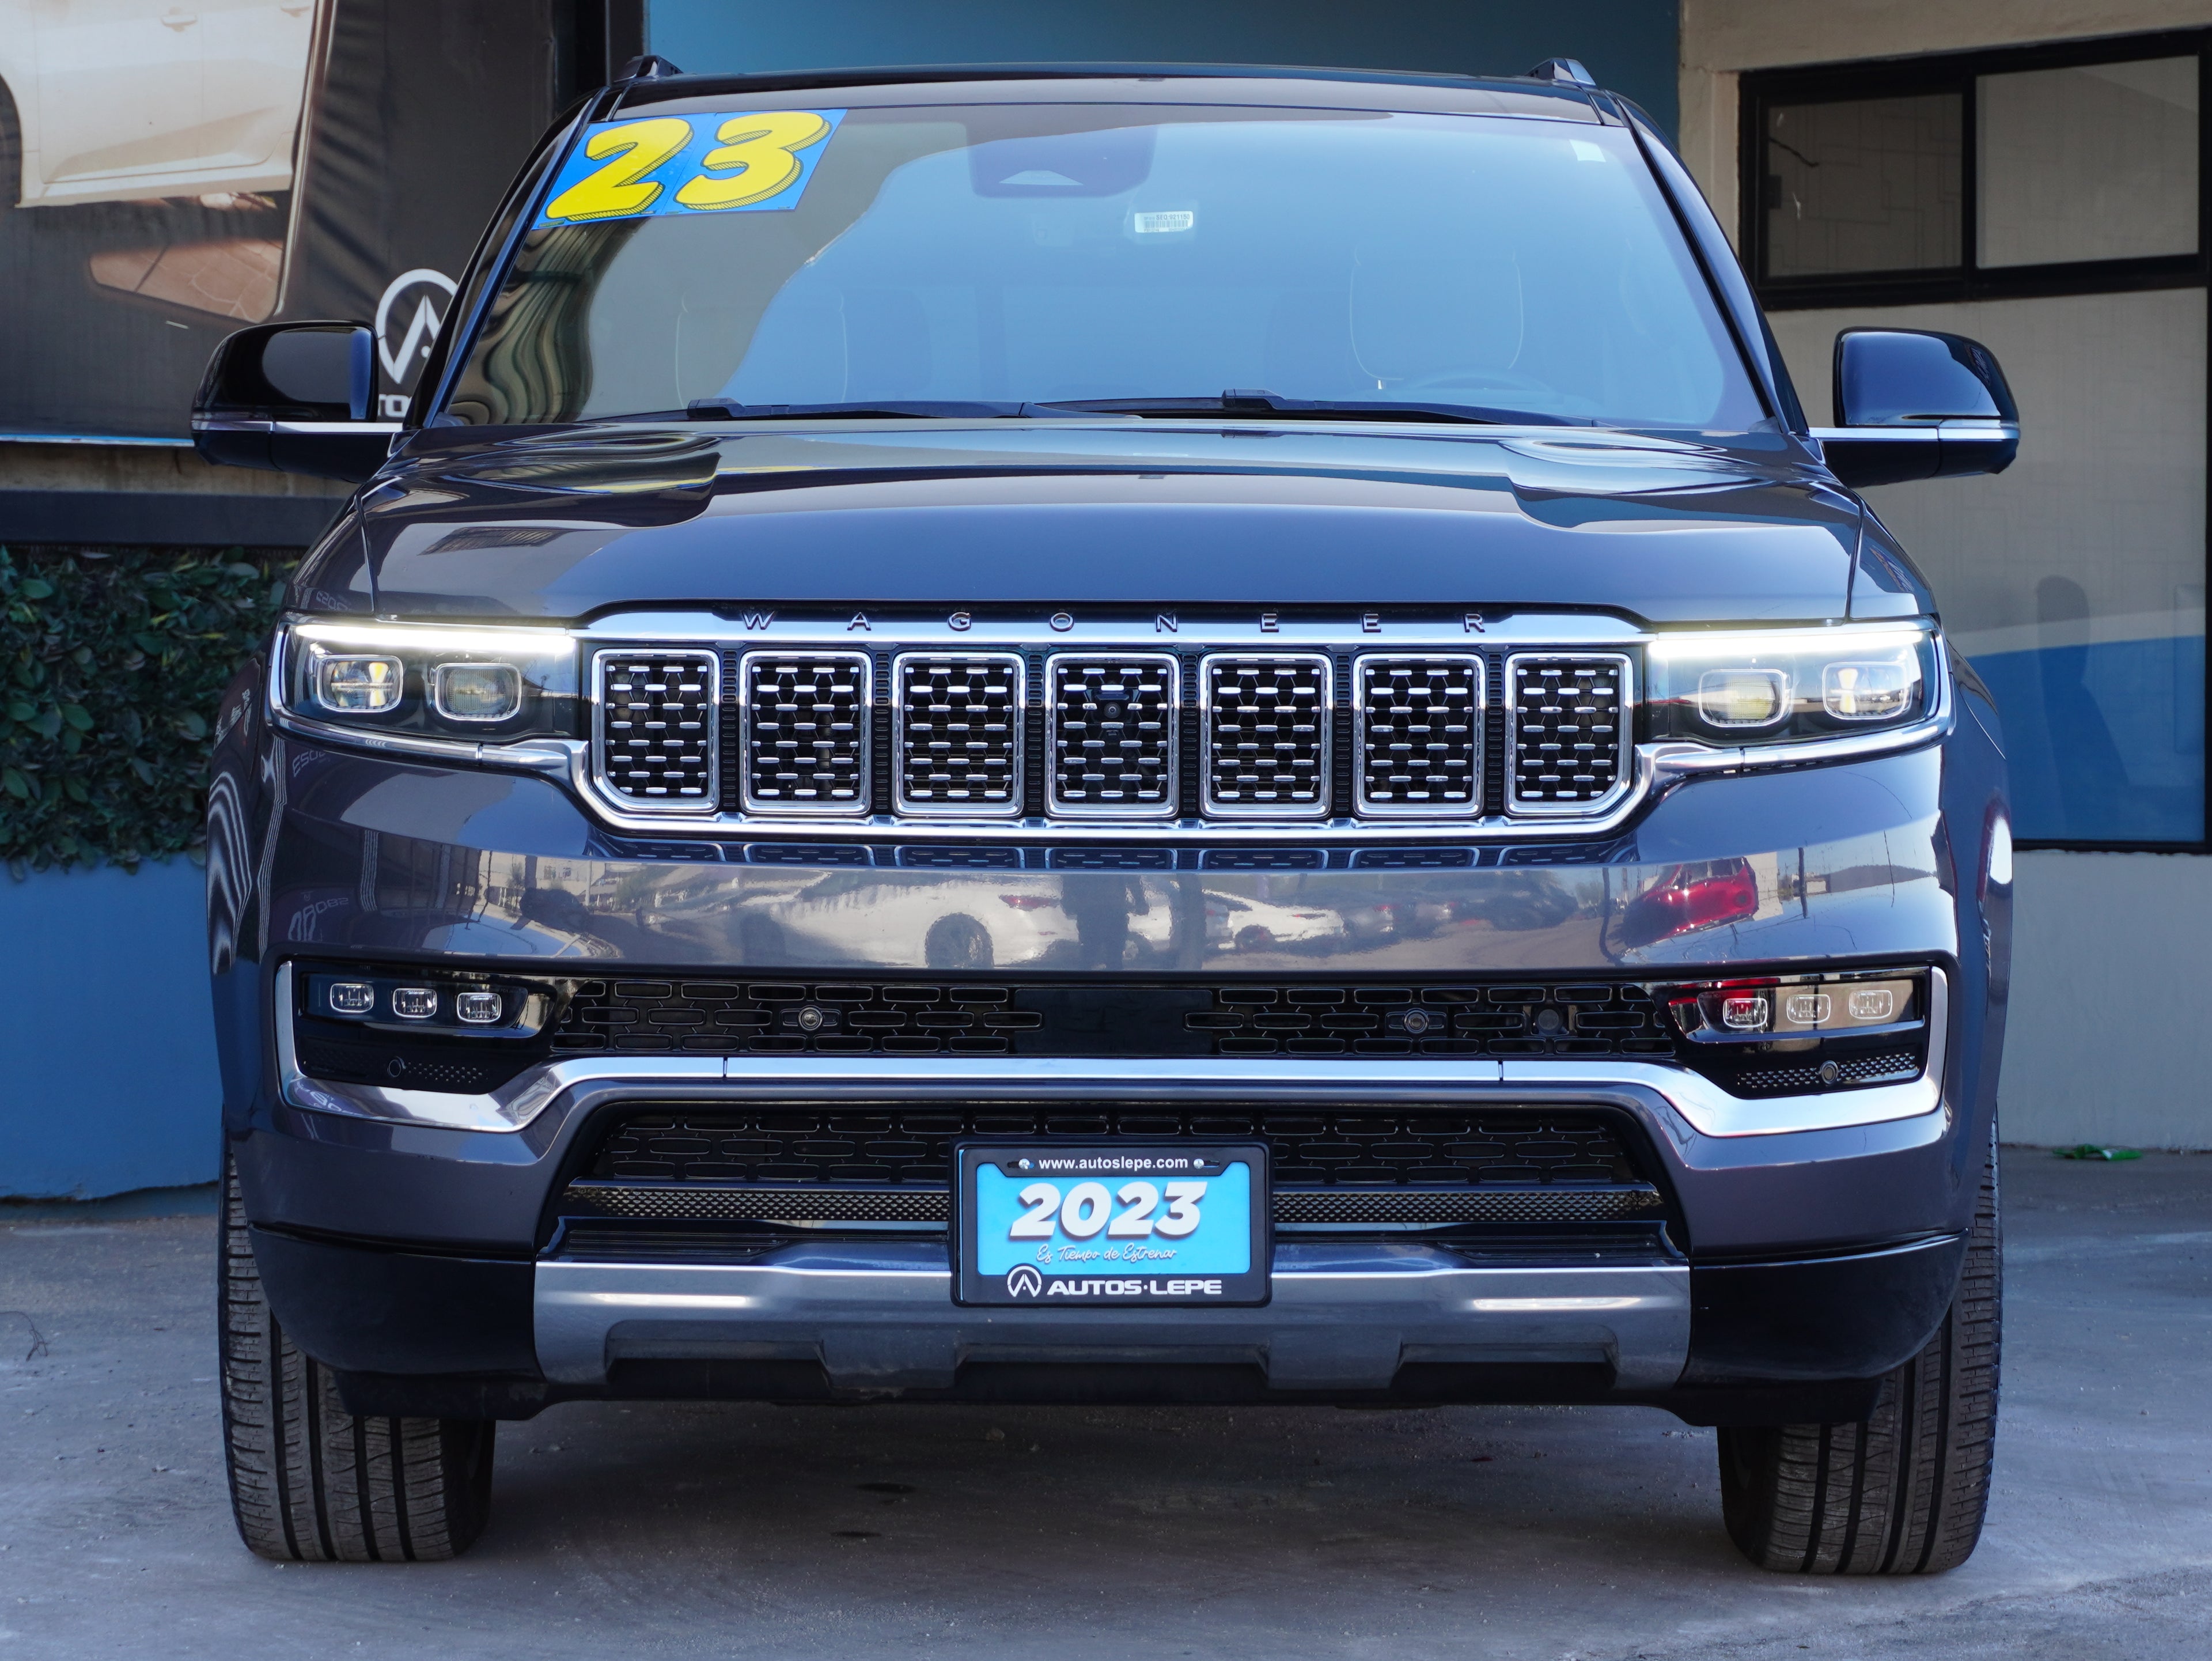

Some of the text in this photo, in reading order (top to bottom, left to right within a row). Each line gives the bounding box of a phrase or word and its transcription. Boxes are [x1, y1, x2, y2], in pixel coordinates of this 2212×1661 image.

[545, 112, 832, 222] 23
[742, 611, 1486, 633] WAGONEER
[1039, 1156, 1188, 1171] www.autoslepe.com
[1009, 1182, 1207, 1238] 2023
[1036, 1243, 1177, 1263] Es Tiempo de Estrenar
